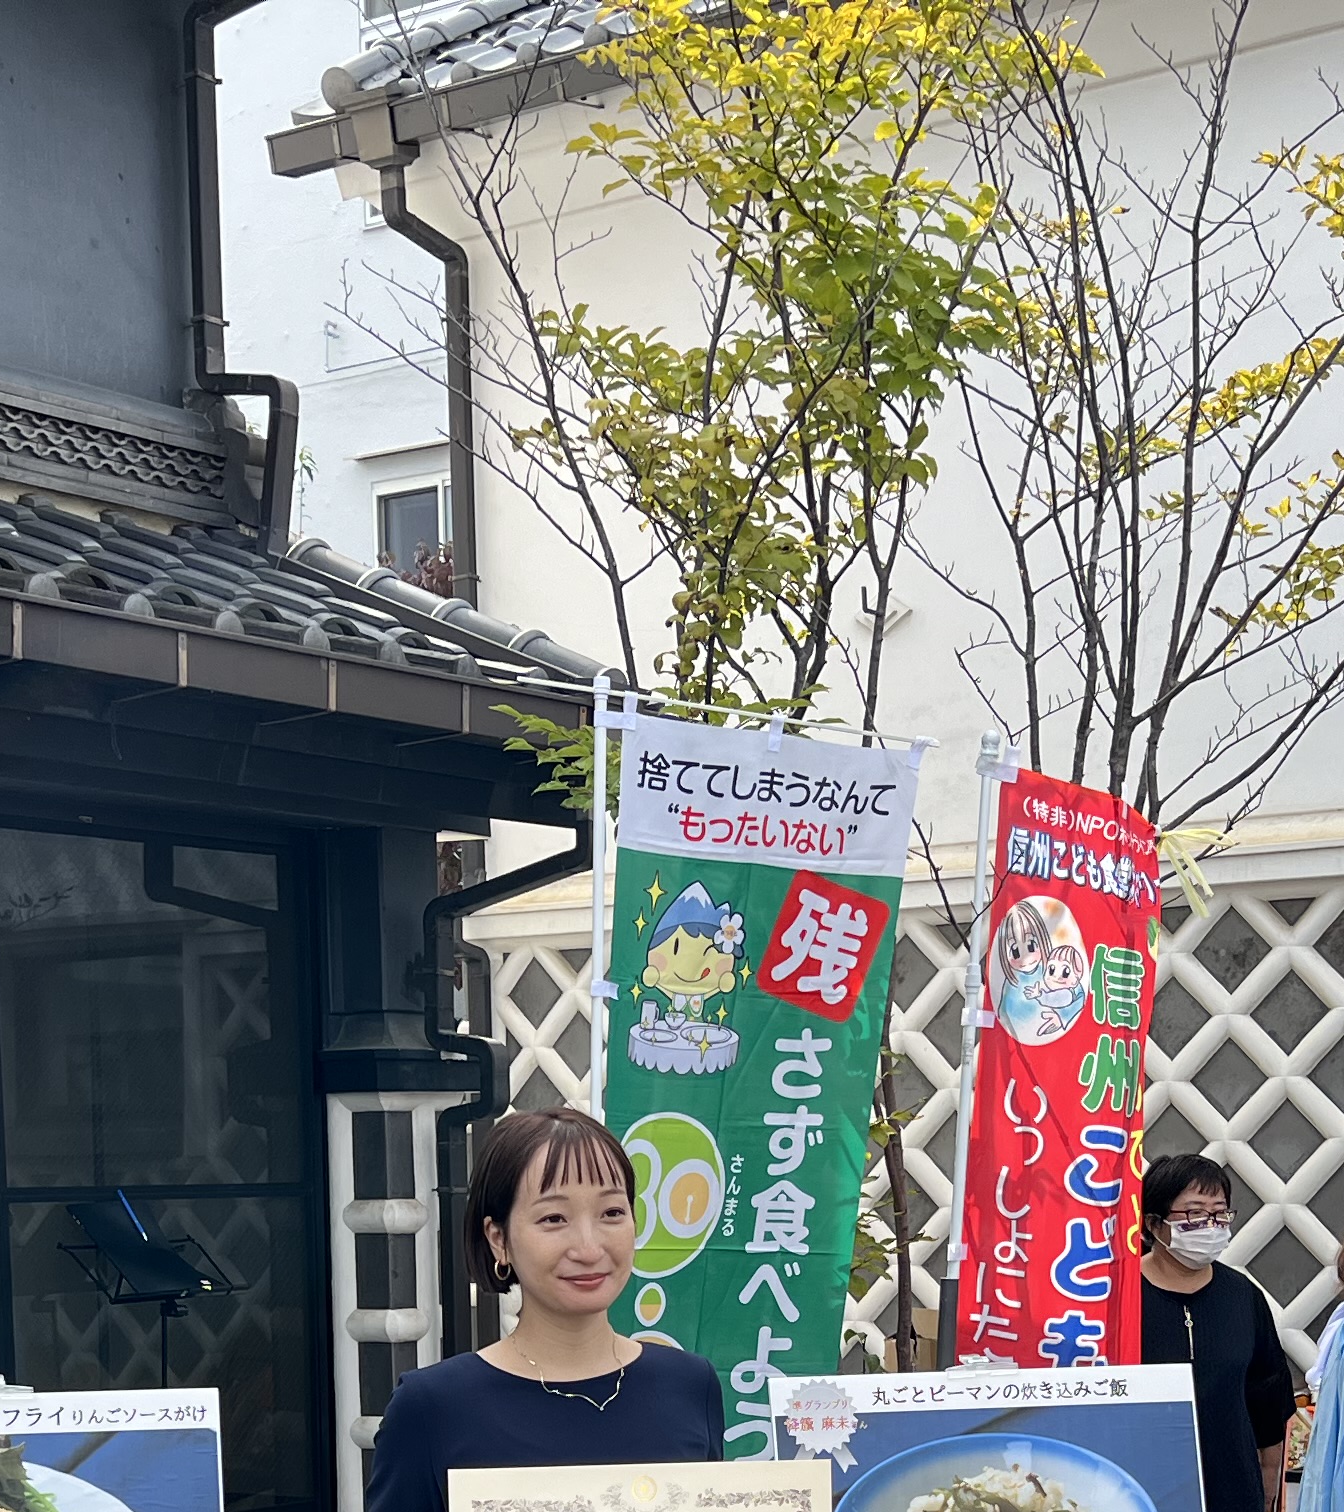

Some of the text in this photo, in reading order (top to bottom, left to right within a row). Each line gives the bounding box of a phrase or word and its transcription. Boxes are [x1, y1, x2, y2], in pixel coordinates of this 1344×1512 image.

[637, 750, 897, 816] 捨ててしまうなんて
[722, 1154, 744, 1237] さんまる
[872, 1378, 1128, 1406] 丸ごとピーマンの炊き込みご飯
